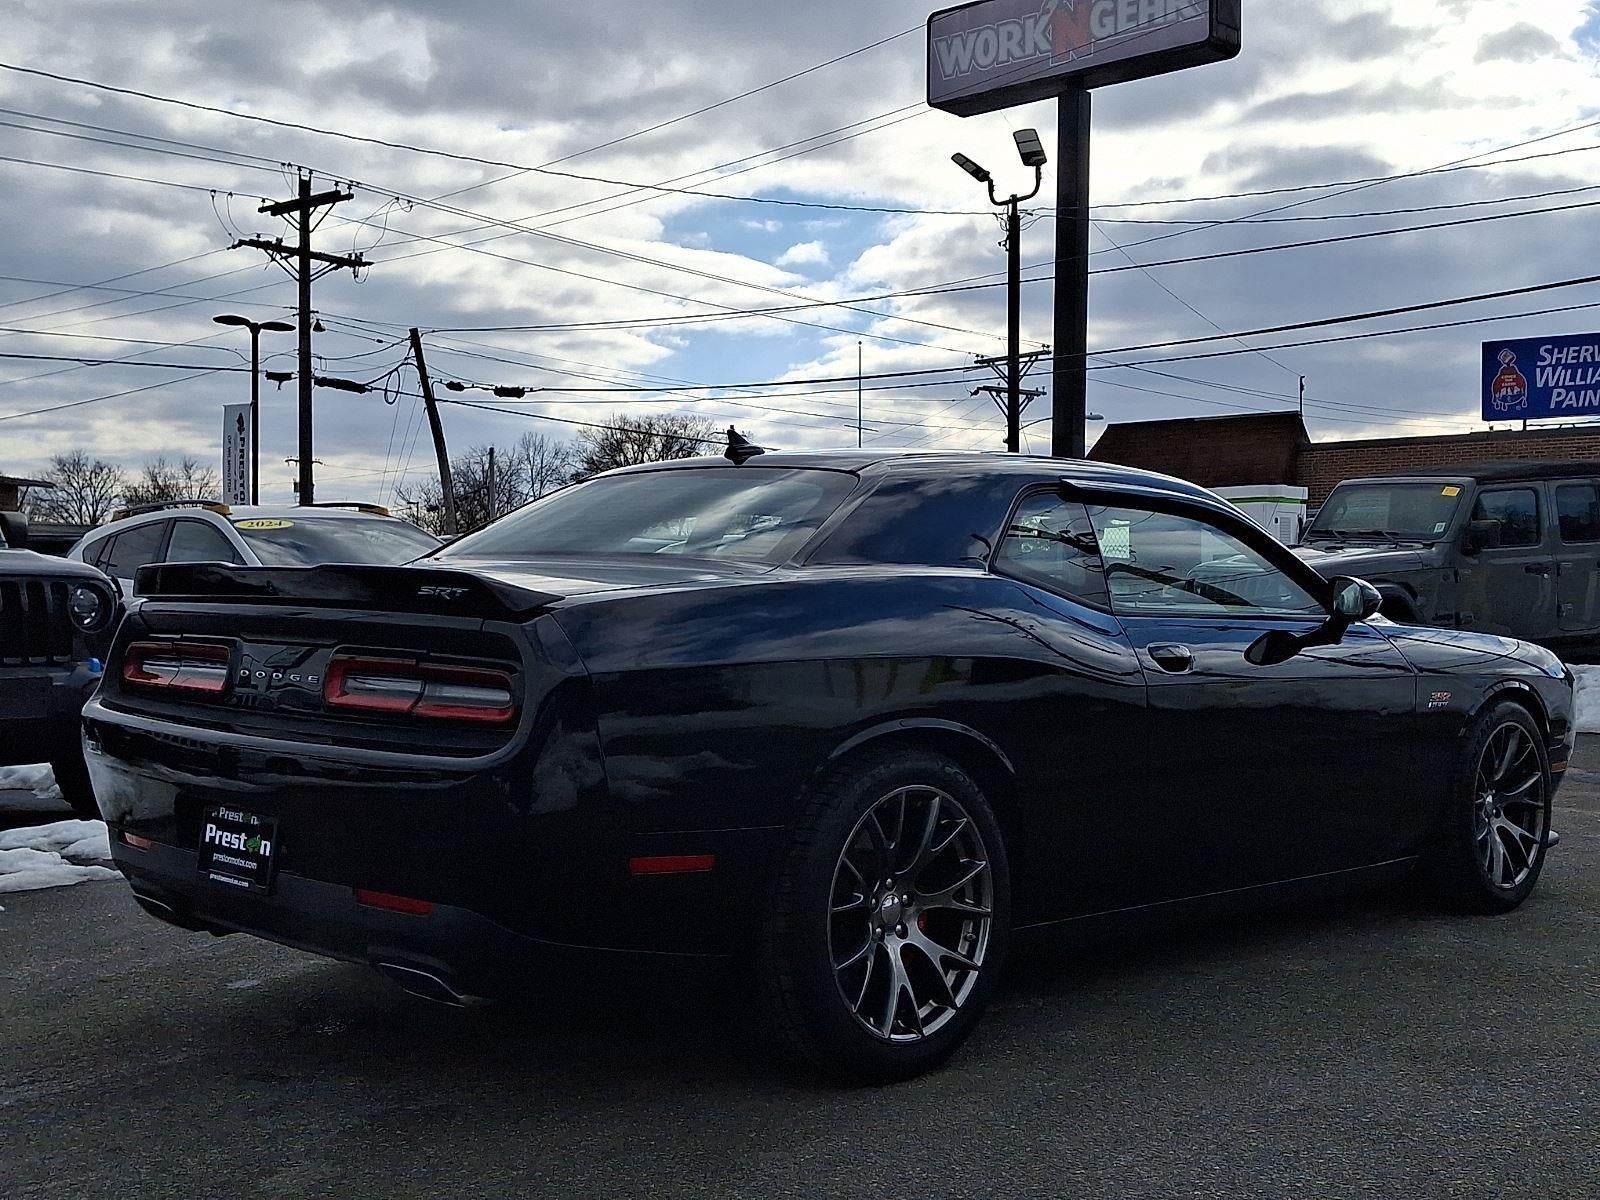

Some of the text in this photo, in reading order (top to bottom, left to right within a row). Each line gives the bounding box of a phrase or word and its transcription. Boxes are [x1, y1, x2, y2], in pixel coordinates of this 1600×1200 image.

[935, 11, 1052, 78] WORK
[247, 520, 282, 528] 2024
[417, 586, 470, 600] SRT
[239, 669, 320, 684] DODGE
[205, 823, 271, 856] Preston
